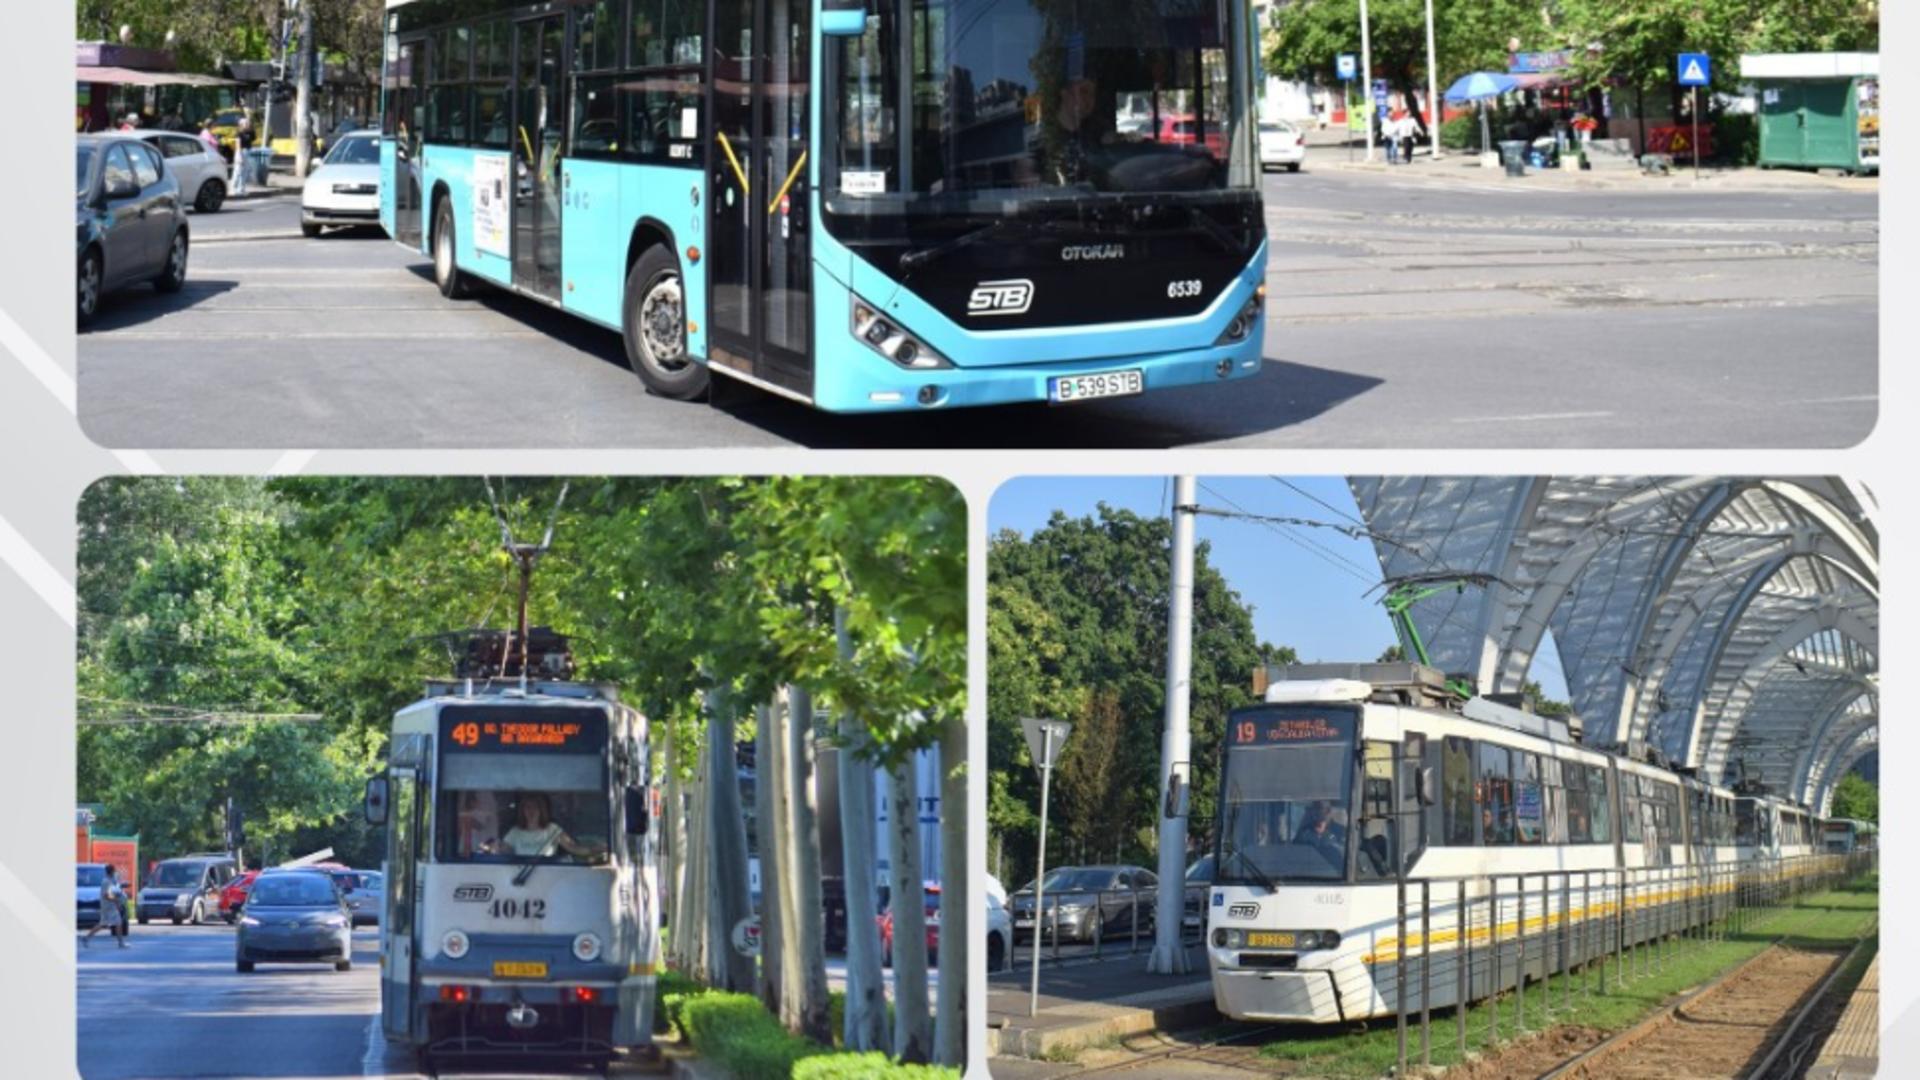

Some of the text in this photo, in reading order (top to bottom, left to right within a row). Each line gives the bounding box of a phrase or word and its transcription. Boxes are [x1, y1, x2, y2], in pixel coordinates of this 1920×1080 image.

[967, 284, 1029, 311] STB
[1167, 280, 1202, 298] 6539
[1060, 373, 1140, 399] B 539 STB
[452, 722, 479, 745] 49
[1237, 721, 1256, 743] 19
[453, 886, 491, 900] STB
[487, 898, 547, 919] 4042
[1227, 903, 1258, 918] STB
